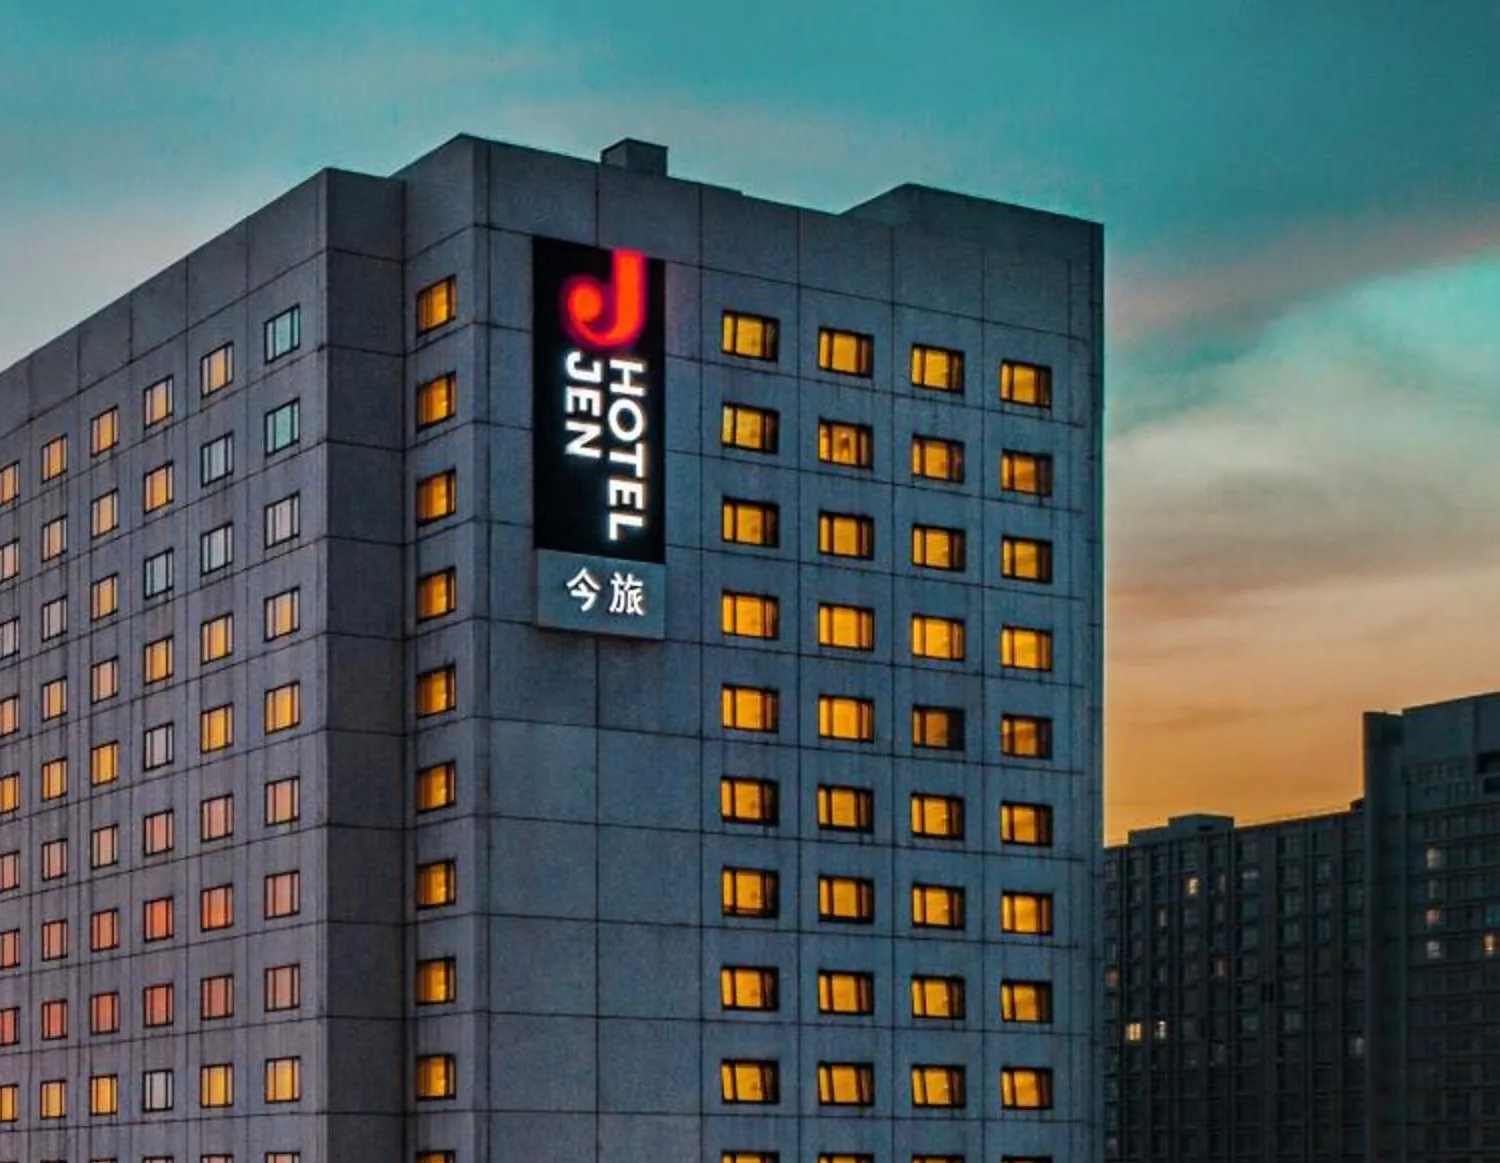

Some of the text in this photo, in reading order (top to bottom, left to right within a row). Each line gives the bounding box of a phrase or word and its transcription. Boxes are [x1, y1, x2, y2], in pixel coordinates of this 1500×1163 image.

[565, 350, 602, 459] JEN
[608, 357, 647, 542] HOTEL
[565, 567, 647, 617] 今旅
